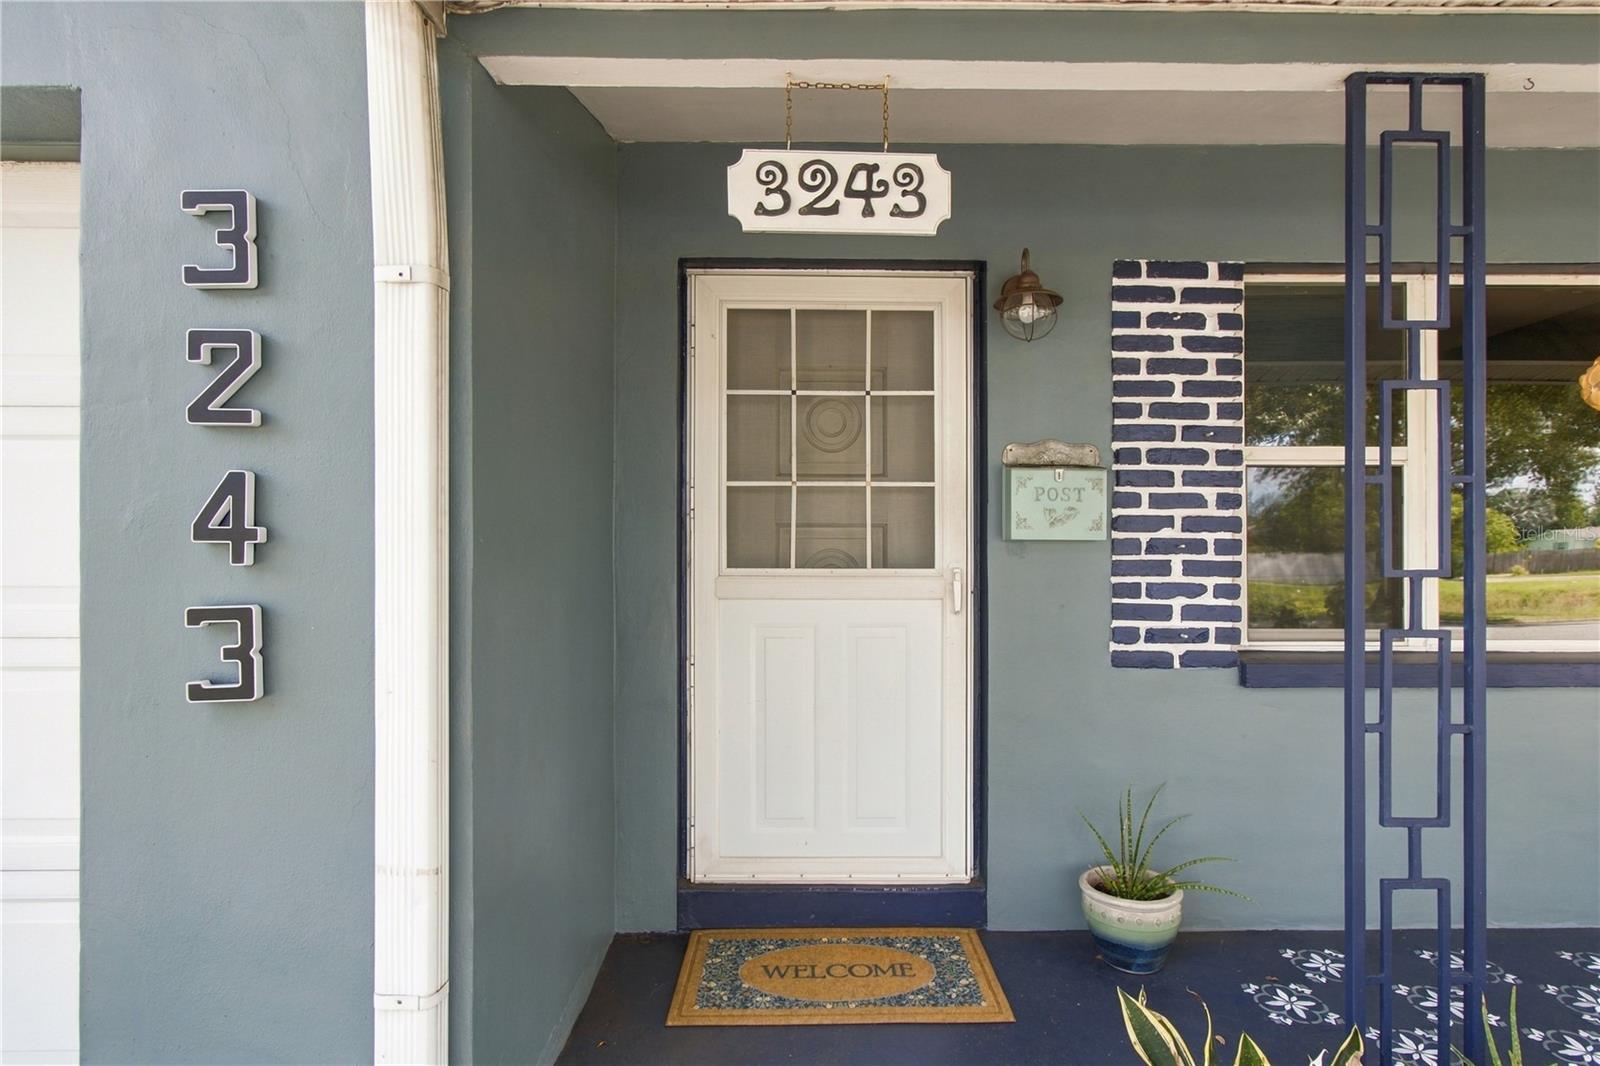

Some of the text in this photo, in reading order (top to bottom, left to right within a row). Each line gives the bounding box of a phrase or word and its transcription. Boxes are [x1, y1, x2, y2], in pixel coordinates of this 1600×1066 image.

[754, 159, 927, 218] 3243
[1034, 486, 1086, 502] POST
[762, 963, 916, 979] WELCOME
